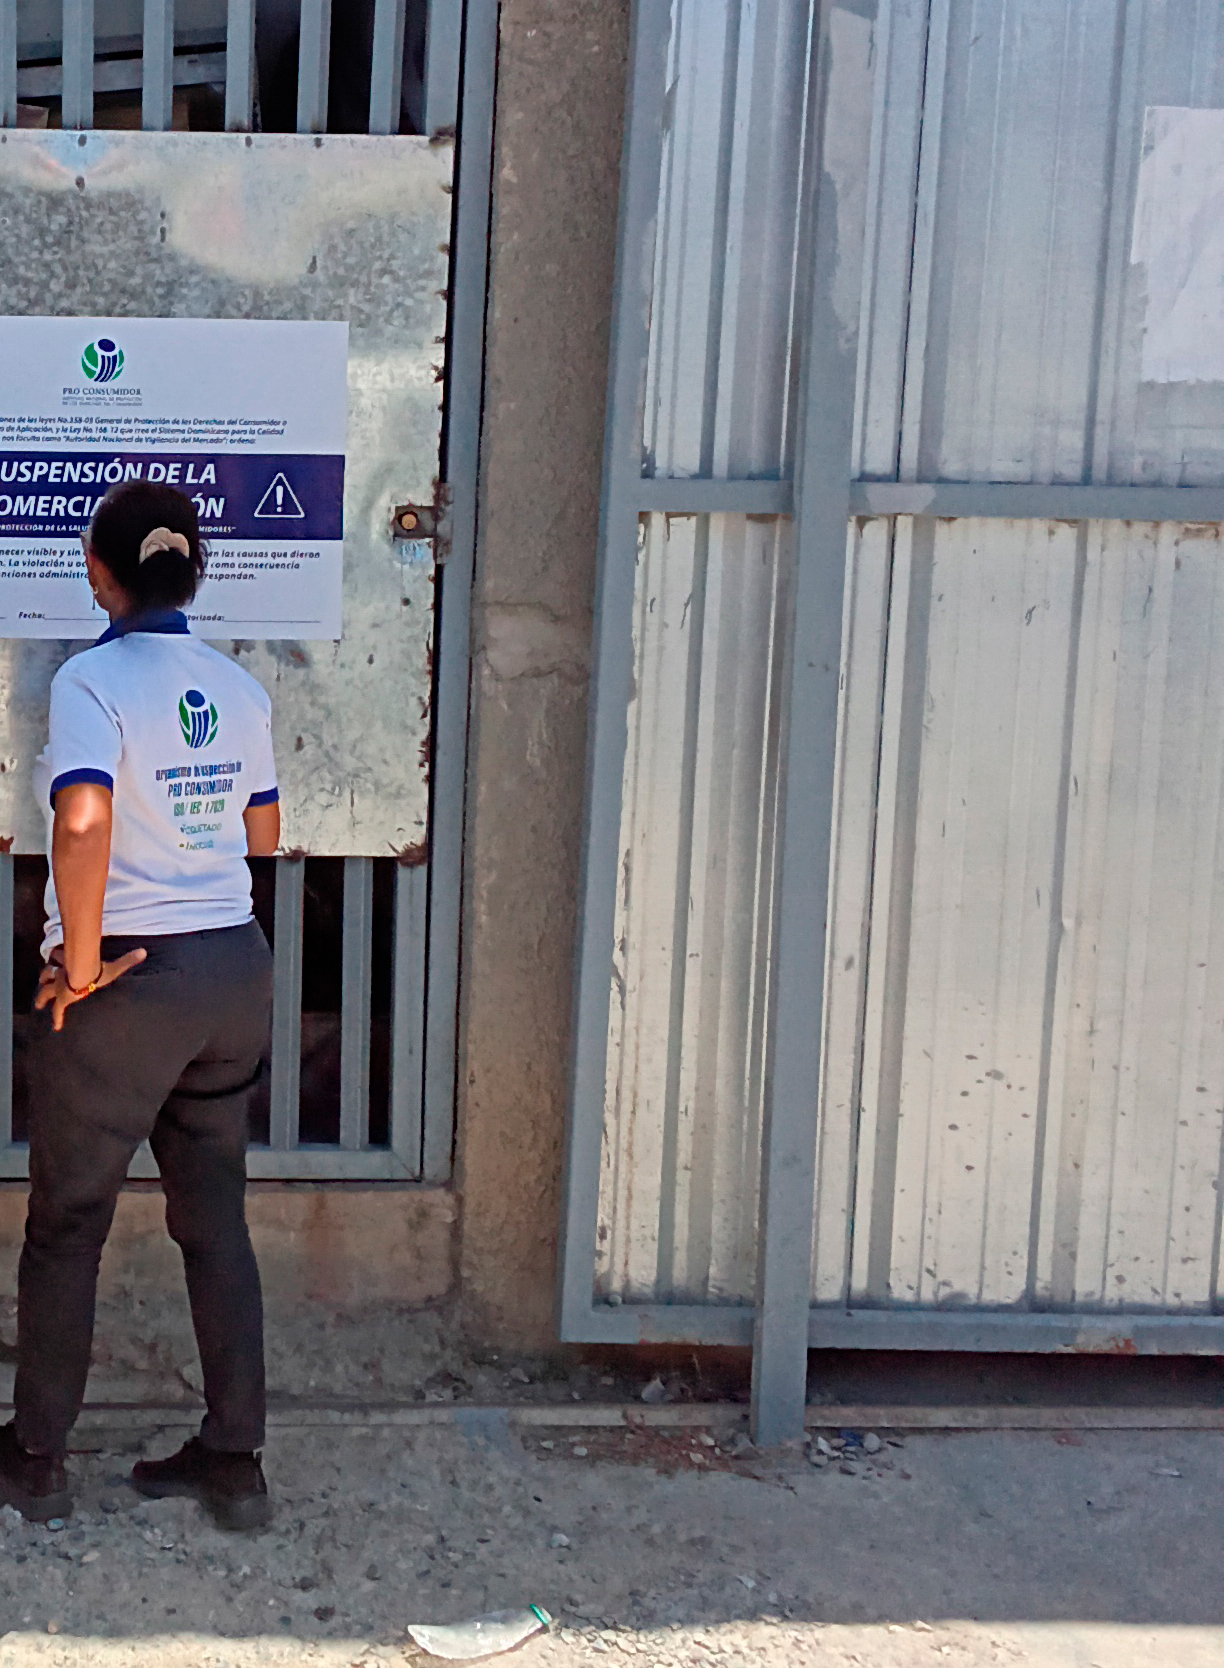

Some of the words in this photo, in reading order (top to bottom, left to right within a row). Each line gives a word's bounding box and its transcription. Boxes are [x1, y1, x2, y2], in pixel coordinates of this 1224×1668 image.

[82, 387, 142, 395] CONSUMIDOR
[94, 416, 123, 425] General
[147, 462, 182, 484] DE
[185, 463, 217, 484] LA
[68, 524, 88, 532] SALU
[26, 547, 58, 556] visible
[58, 549, 67, 558] y
[67, 547, 81, 556] sin
[221, 548, 235, 558] las
[236, 551, 269, 559] causas
[270, 551, 288, 559] que
[290, 549, 321, 559] dieron
[7, 559, 20, 567] La
[21, 558, 65, 567] violación
[237, 560, 300, 569] consecuencia
[38, 570, 89, 579] administra
[18, 611, 46, 619] Fecha:
